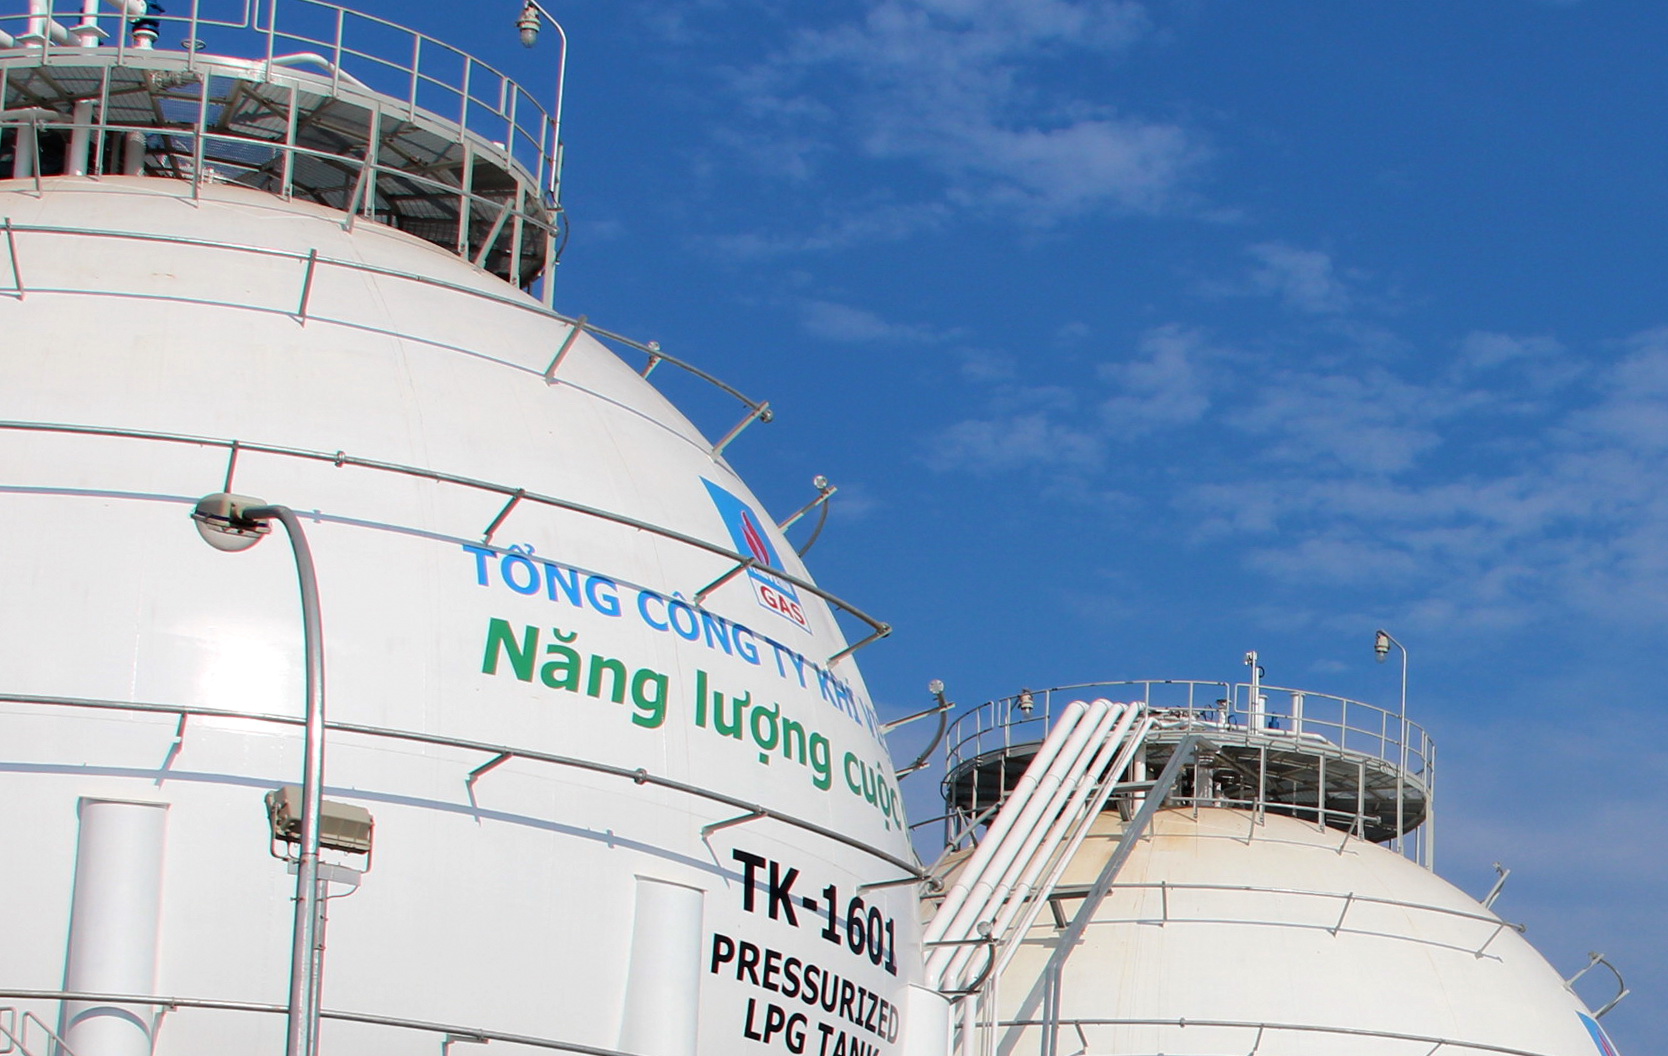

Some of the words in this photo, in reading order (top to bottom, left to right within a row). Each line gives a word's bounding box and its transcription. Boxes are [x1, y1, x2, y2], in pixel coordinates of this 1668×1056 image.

[463, 542, 622, 617] TỔNG
[637, 592, 761, 665] CÔNG
[764, 636, 807, 688] TY
[760, 586, 806, 625] GAS
[481, 618, 669, 728] Năng
[695, 669, 832, 791] lượng
[844, 751, 902, 832] cuộc
[732, 848, 898, 977] TK-1601
[710, 933, 899, 1044] PRESSURIZED
[744, 997, 808, 1054] LPG
